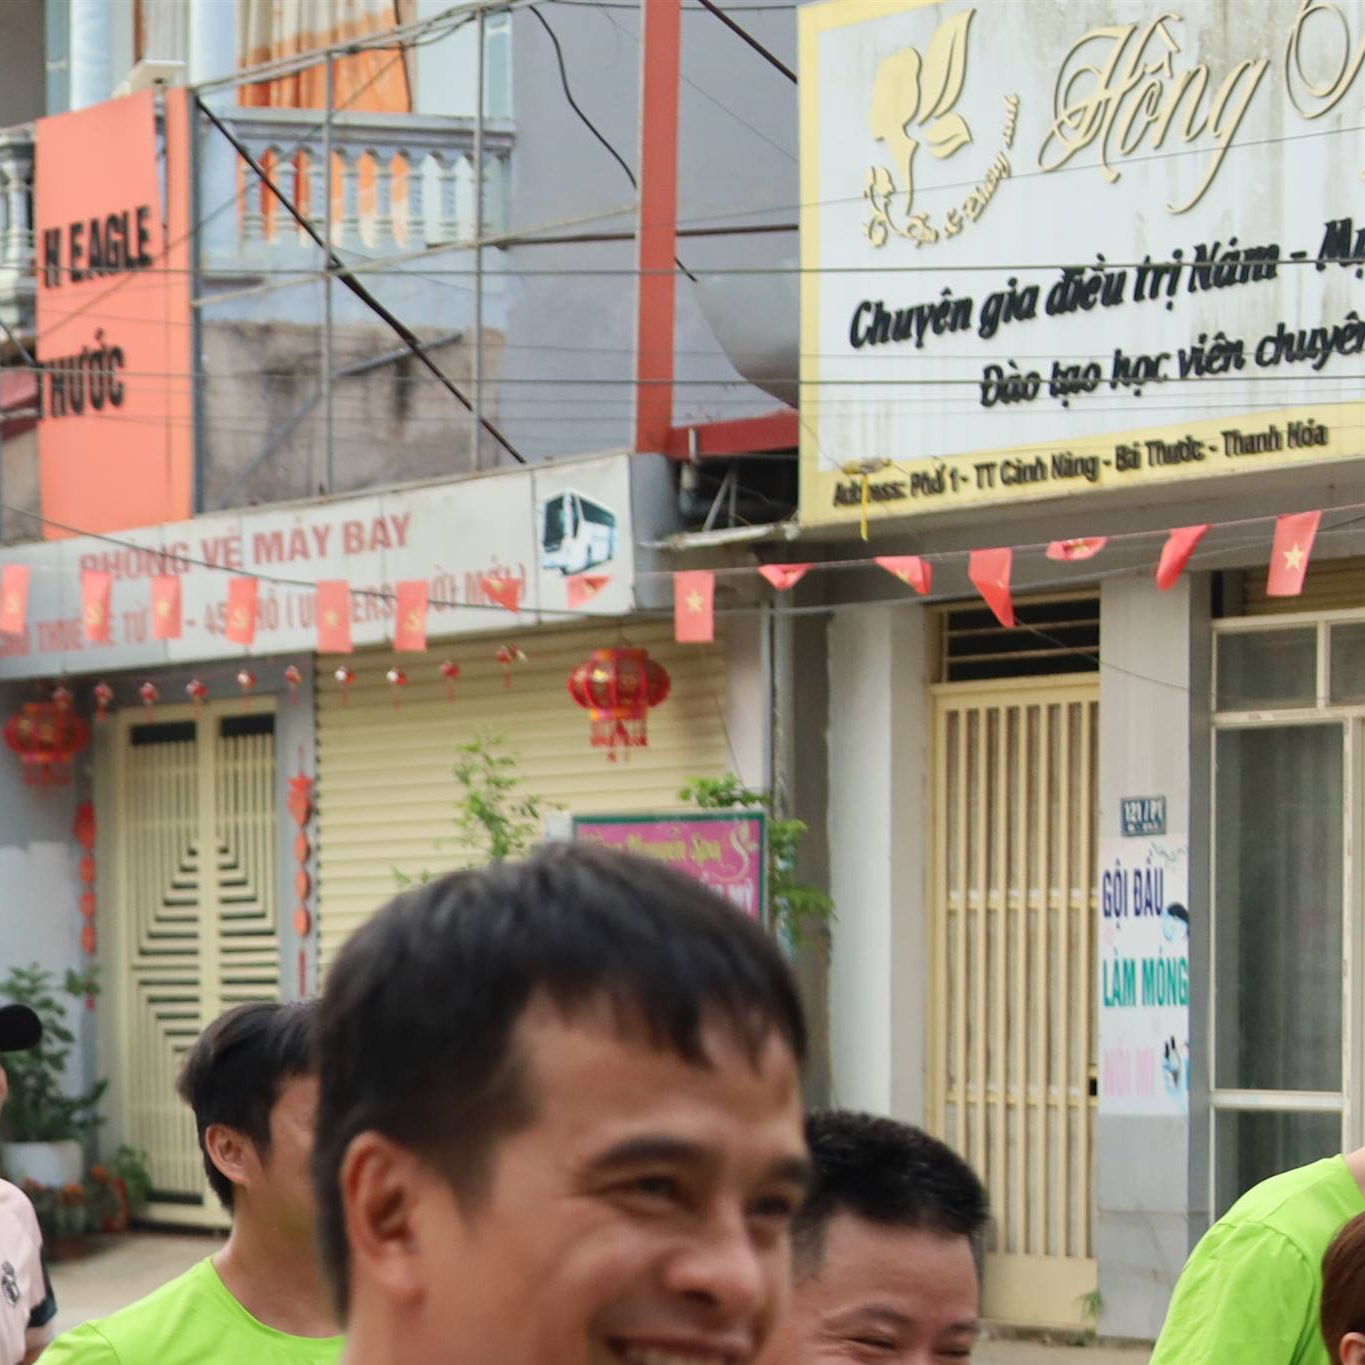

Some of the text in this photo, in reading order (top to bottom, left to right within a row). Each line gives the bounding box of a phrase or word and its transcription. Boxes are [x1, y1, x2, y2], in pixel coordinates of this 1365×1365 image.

[70, 204, 154, 283] EAGLE
[850, 286, 973, 349] Chuyên
[978, 277, 1040, 339] gia
[1045, 253, 1126, 316] điều
[1133, 249, 1183, 311] trị
[1188, 237, 1280, 292] Nám
[979, 359, 1041, 408] Đào
[1049, 360, 1102, 408] tạo
[1110, 348, 1171, 397] học
[1178, 331, 1246, 379] viên
[974, 462, 997, 489] TT
[1221, 424, 1284, 457] Thanh
[201, 525, 244, 570] VÉ
[253, 515, 332, 565] MÁY
[342, 512, 412, 555] BAY
[1103, 947, 1136, 1007] LÀM
